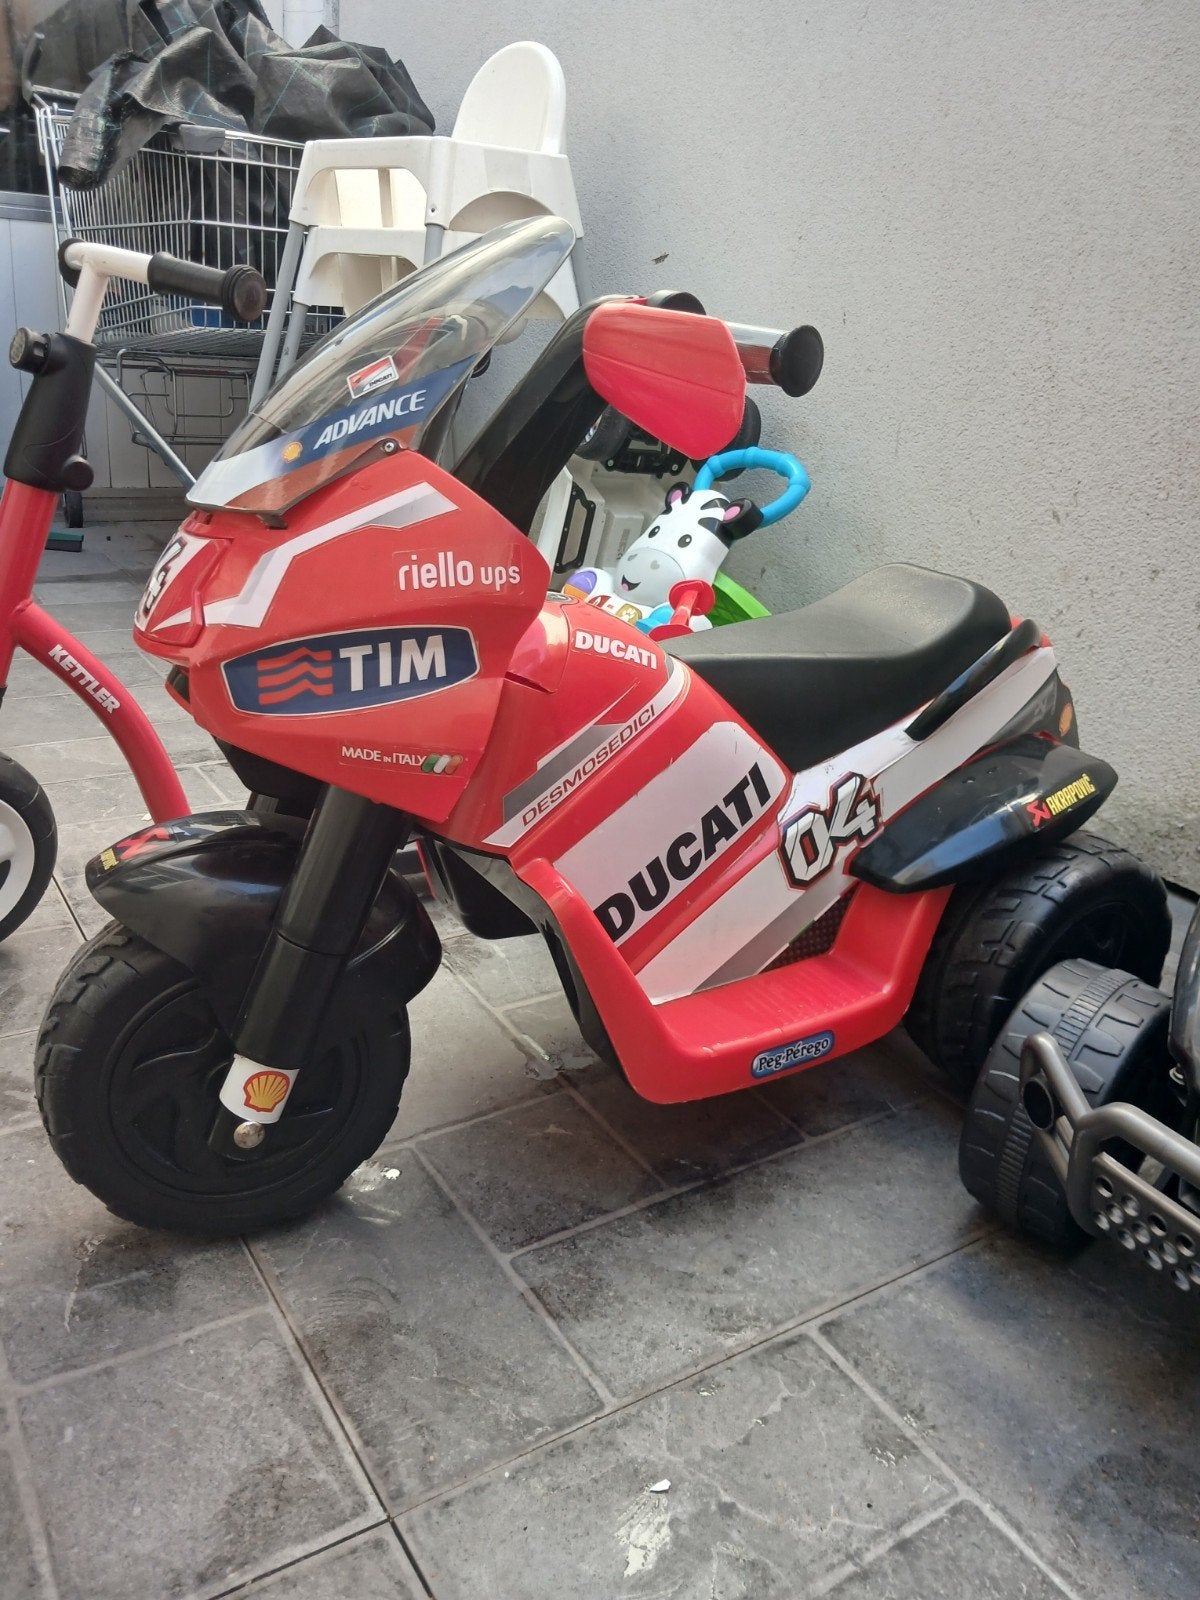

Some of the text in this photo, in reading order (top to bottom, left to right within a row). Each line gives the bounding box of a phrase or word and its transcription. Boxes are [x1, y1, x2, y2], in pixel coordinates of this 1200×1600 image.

[312, 389, 427, 450] ADVANCE
[398, 551, 521, 591] riello ups
[48, 644, 121, 714] KETTLER
[339, 634, 447, 692] TIM
[574, 630, 658, 670] DUCATI
[341, 746, 382, 762] MADE
[392, 752, 427, 766] ITALY
[522, 704, 656, 827] DESMOSEDICI
[593, 761, 771, 943] DUCATI
[780, 771, 880, 887] 04
